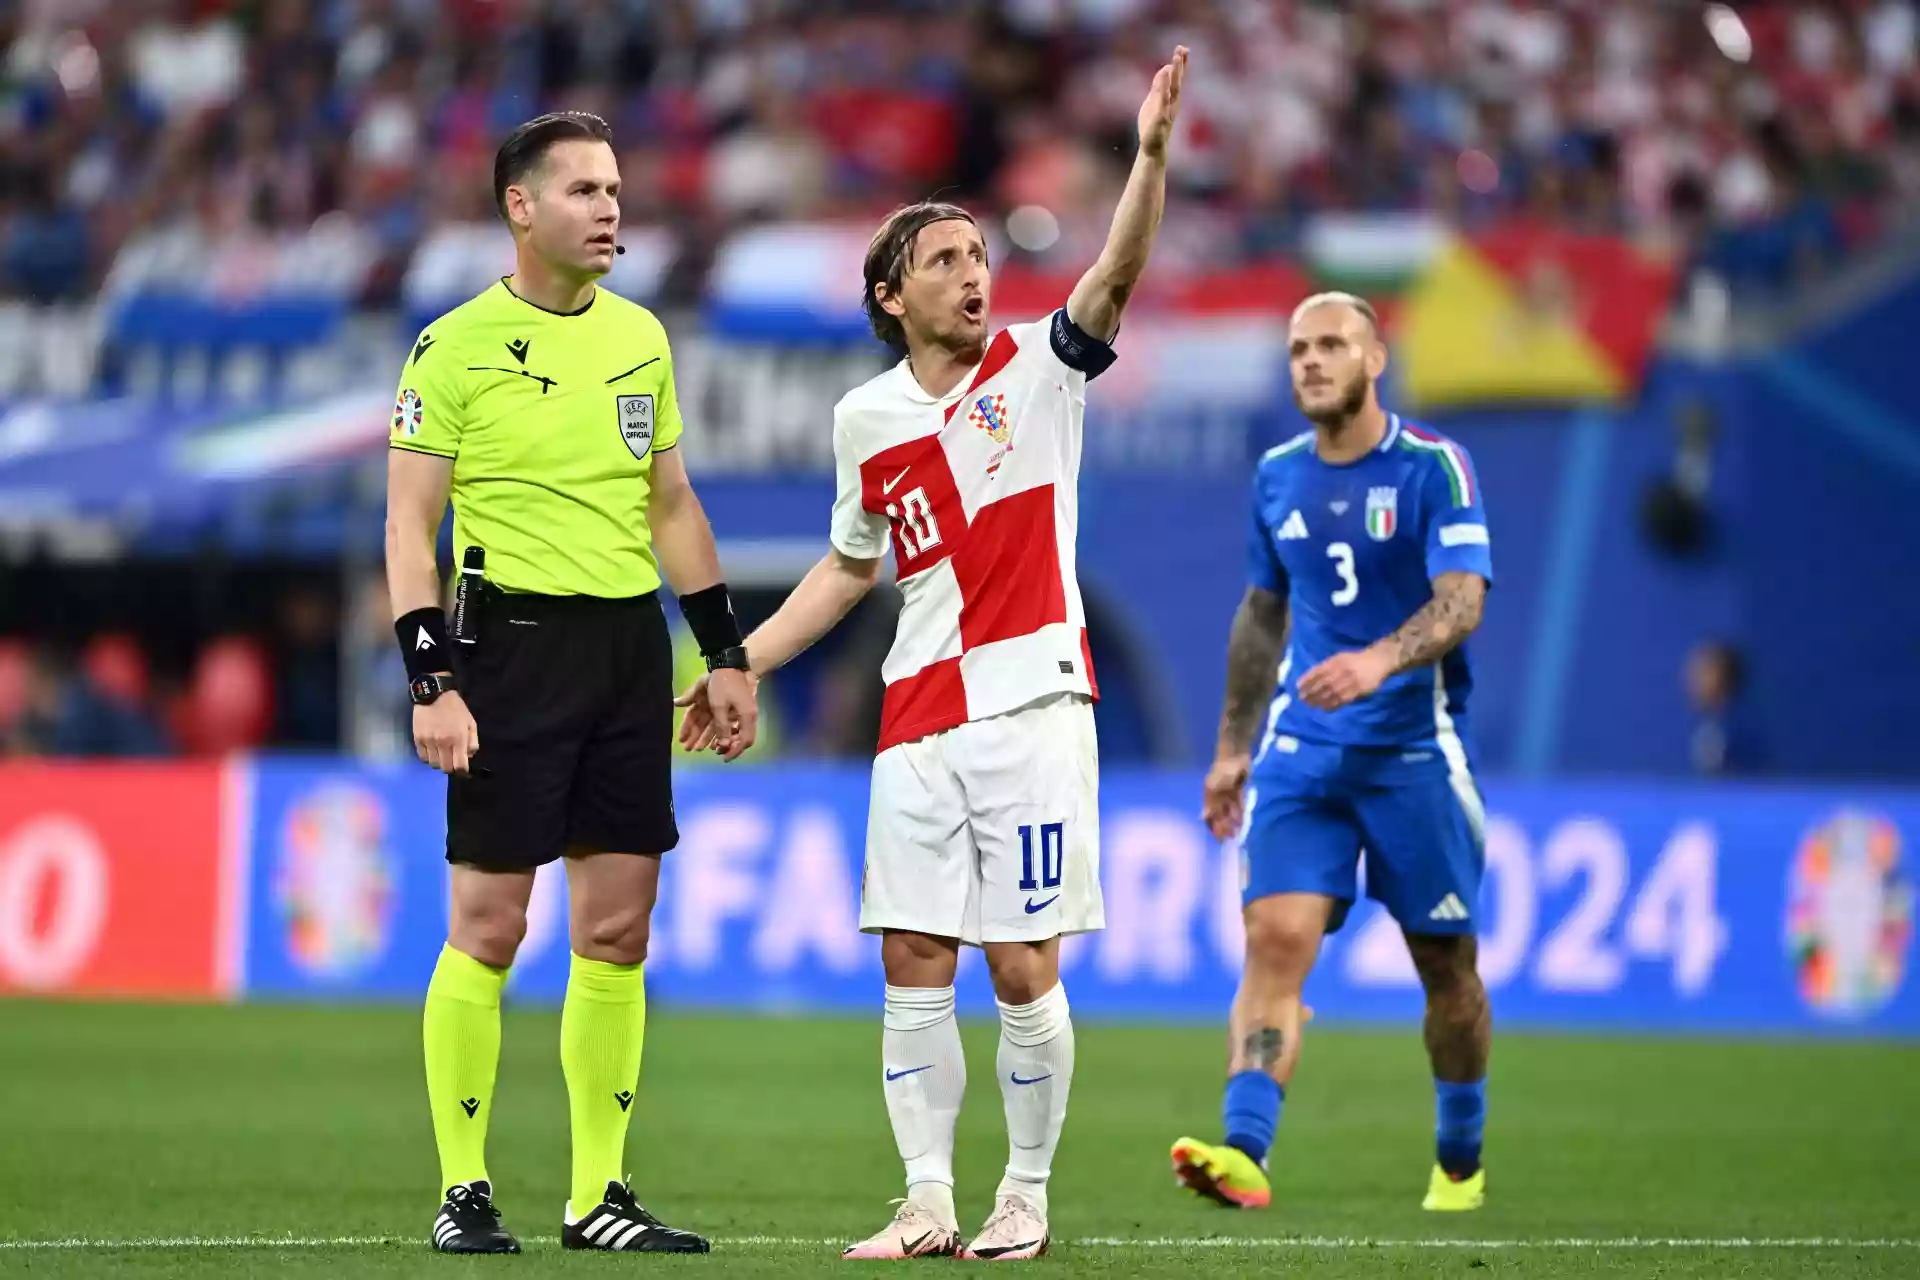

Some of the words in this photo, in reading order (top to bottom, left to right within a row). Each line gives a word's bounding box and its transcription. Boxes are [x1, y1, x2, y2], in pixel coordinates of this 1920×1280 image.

[625, 402, 647, 414] UEFA
[626, 431, 651, 439] OFFICIAL
[627, 421, 648, 429] MATCH
[885, 486, 944, 560] 10
[1326, 541, 1359, 607] 3
[459, 578, 468, 600] SPRAY
[456, 600, 466, 636] VANISHING
[1017, 822, 1063, 891] 10
